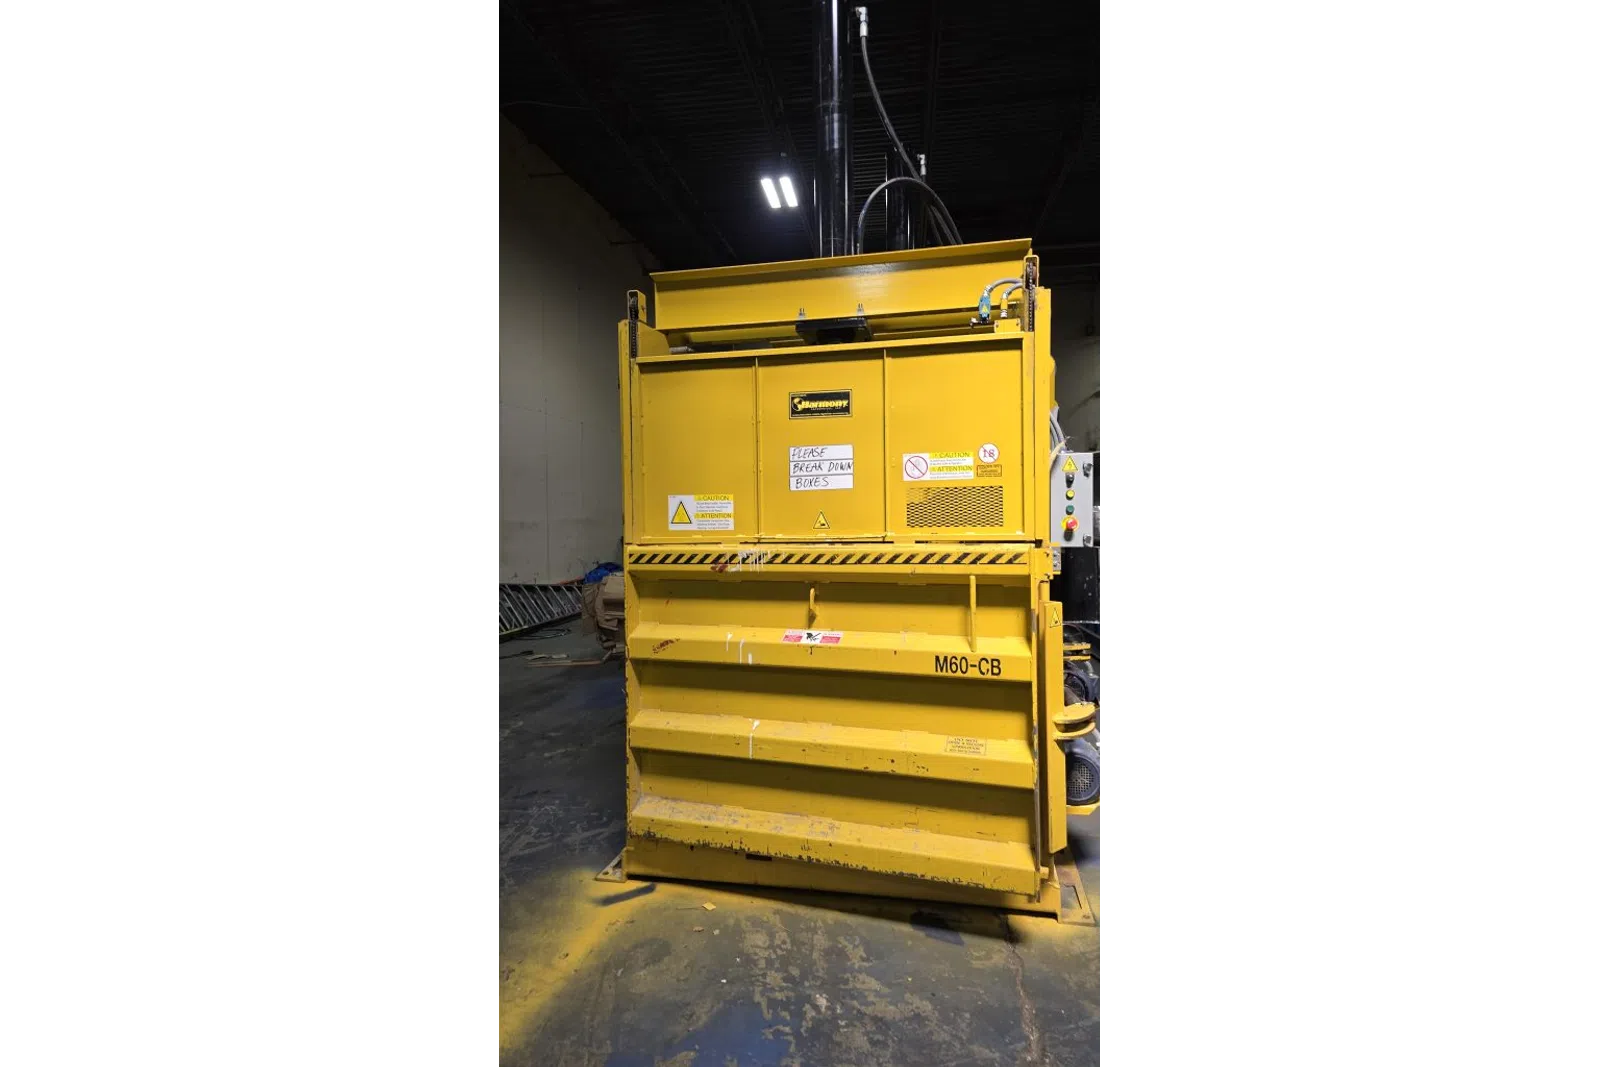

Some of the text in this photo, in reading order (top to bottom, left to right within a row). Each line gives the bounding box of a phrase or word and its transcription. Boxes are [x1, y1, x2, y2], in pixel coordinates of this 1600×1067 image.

[802, 400, 848, 408] Harmony
[792, 446, 828, 459] PLEASE
[793, 461, 853, 474] BREAK DOWN
[796, 476, 829, 489] BOXES
[935, 655, 1001, 676] M60-CB
